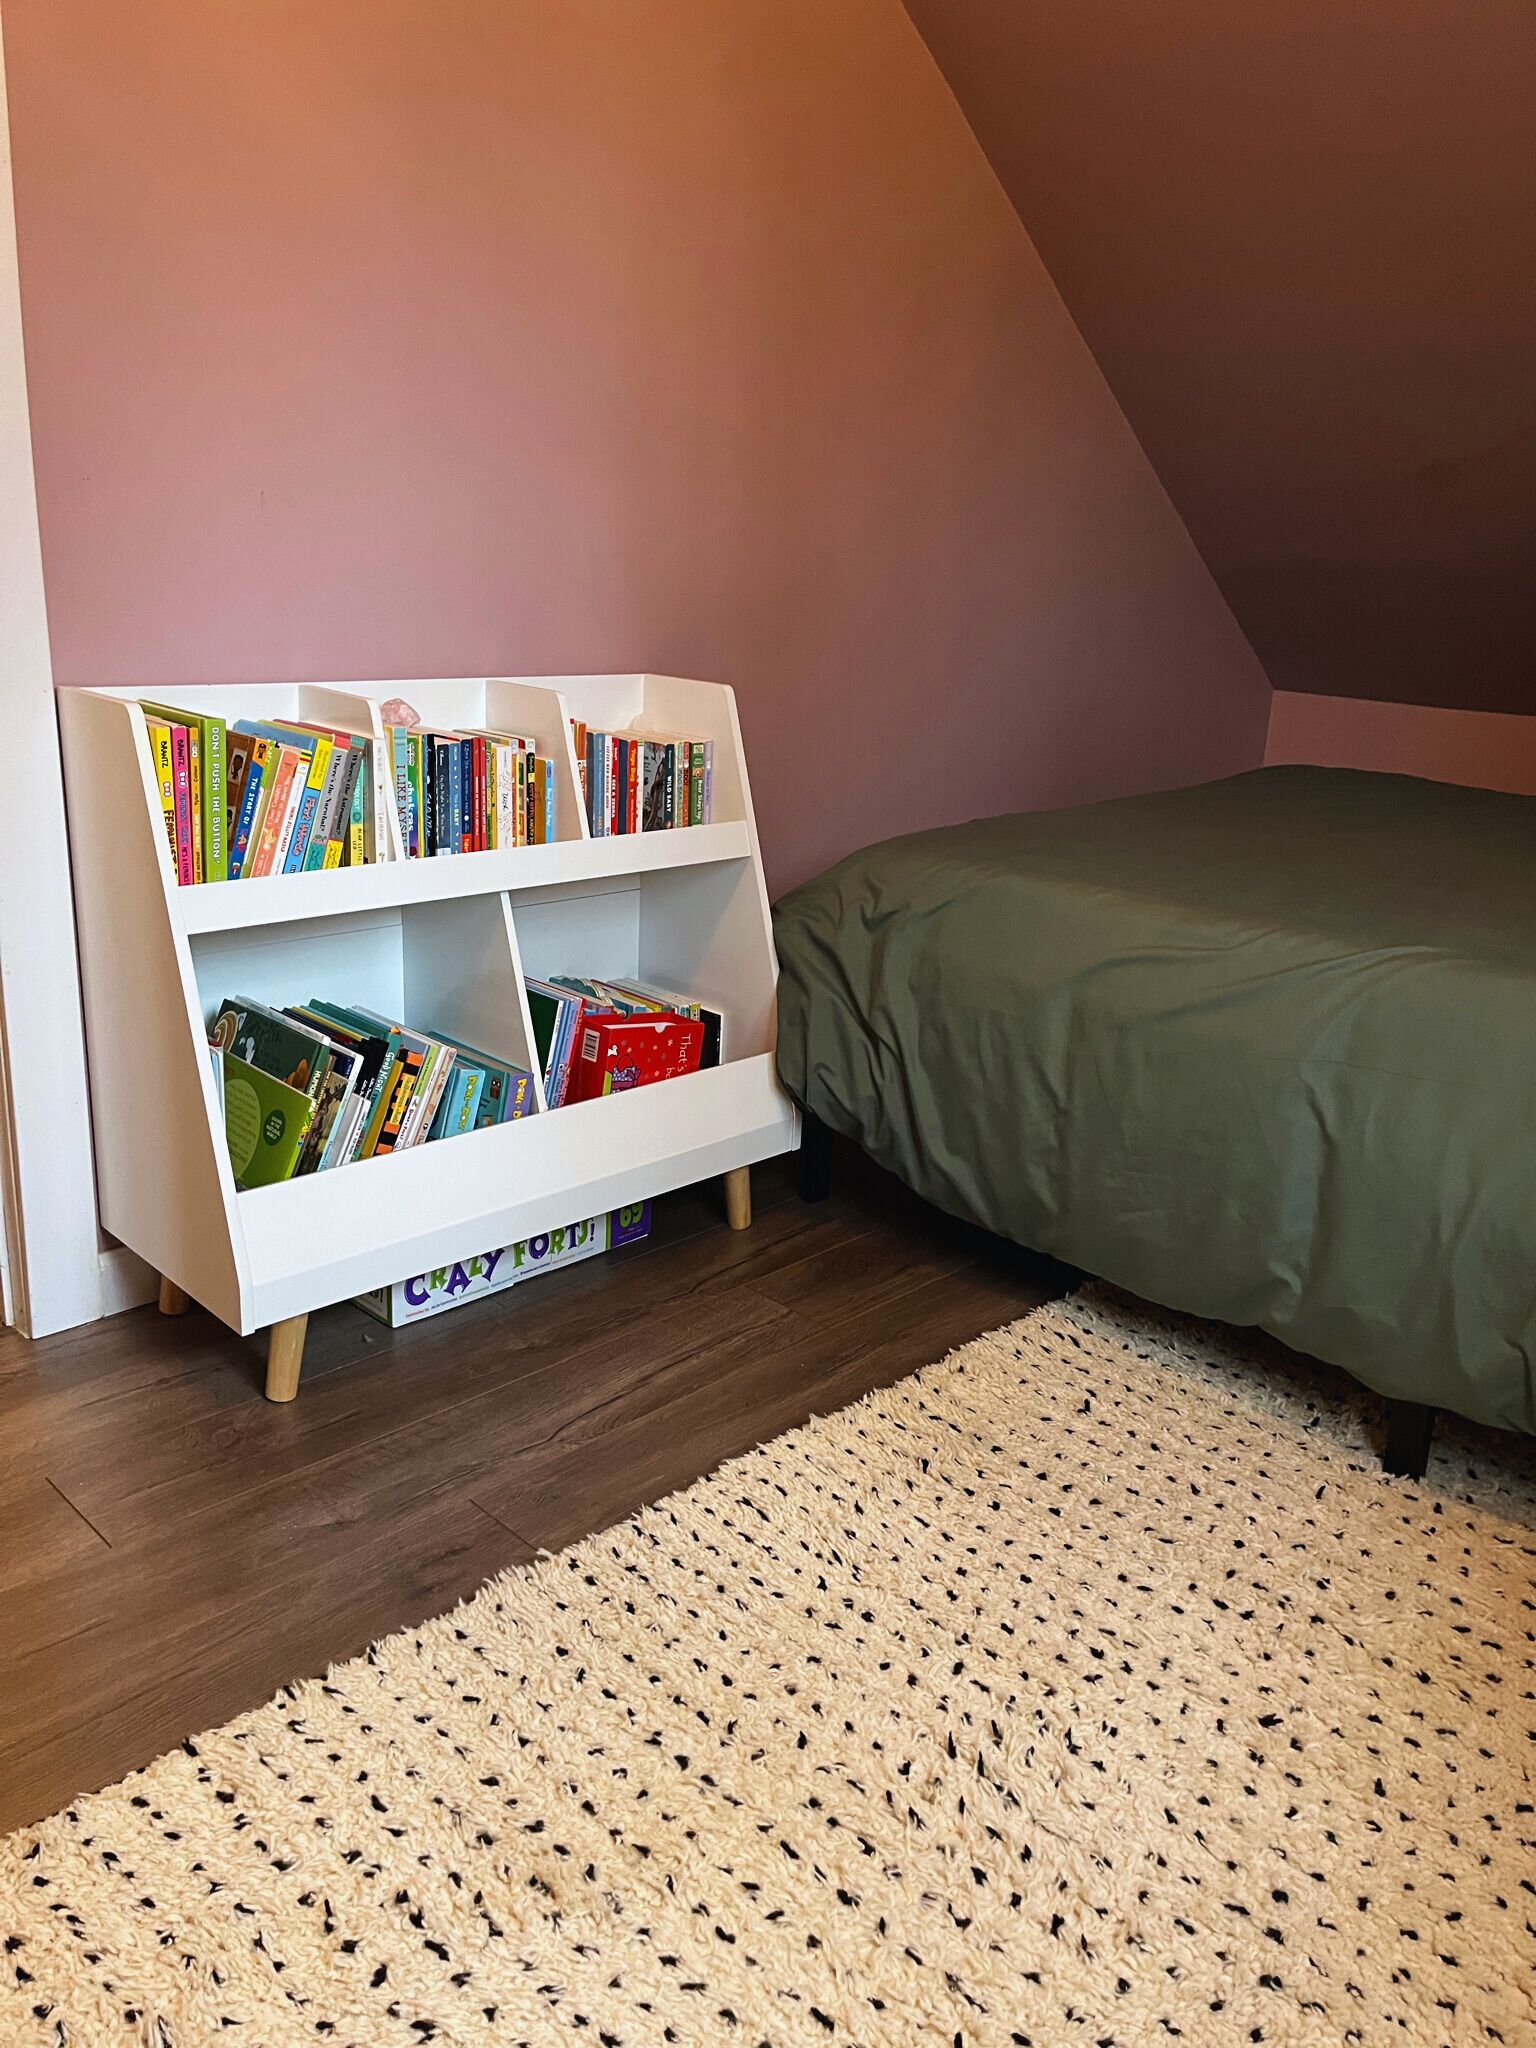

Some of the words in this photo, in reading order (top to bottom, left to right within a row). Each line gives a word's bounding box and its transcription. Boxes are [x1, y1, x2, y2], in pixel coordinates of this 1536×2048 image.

[159, 741, 169, 768] BRANTZ
[175, 739, 186, 767] BRANTZ
[210, 763, 222, 791] PUSH
[329, 754, 342, 782] Where's
[346, 754, 358, 784] Where's
[250, 777, 258, 790] THE
[280, 786, 288, 801] Meet
[327, 783, 335, 797] the
[343, 784, 351, 797] the
[397, 774, 406, 801] LIKE
[211, 796, 221, 812] THE
[244, 792, 255, 814] STORY
[319, 797, 332, 832] Narwhal?
[697, 811, 702, 819] Up
[242, 815, 250, 825] OF
[284, 820, 292, 836] LITTLE
[678, 1034, 692, 1072] That's
[404, 1248, 505, 1306] CRAZY
